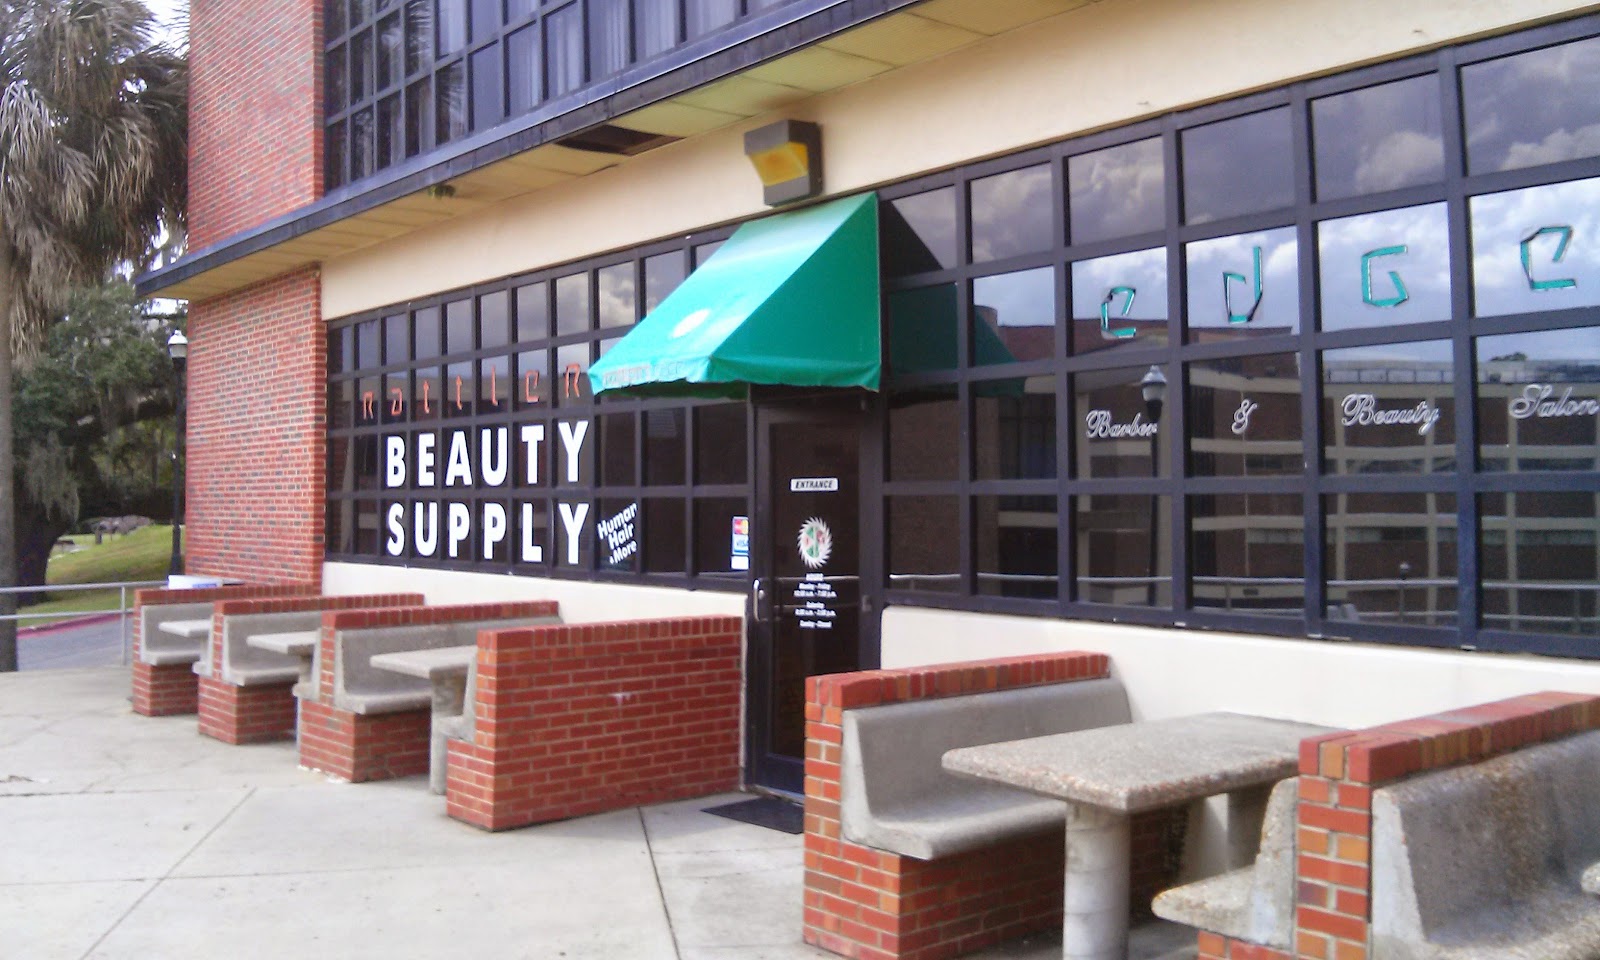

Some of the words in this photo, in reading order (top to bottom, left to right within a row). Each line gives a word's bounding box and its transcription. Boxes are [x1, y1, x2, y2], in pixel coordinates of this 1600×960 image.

[1086, 410, 1158, 438] Barber
[1232, 399, 1257, 435] &
[1341, 394, 1440, 436] Beauty
[1508, 384, 1600, 420] Salon
[386, 420, 589, 488] BEAUTY
[795, 479, 834, 490] ENTRANCE
[386, 501, 590, 565] SUPPLY
[597, 503, 638, 539] Human
[608, 523, 634, 550] Hair
